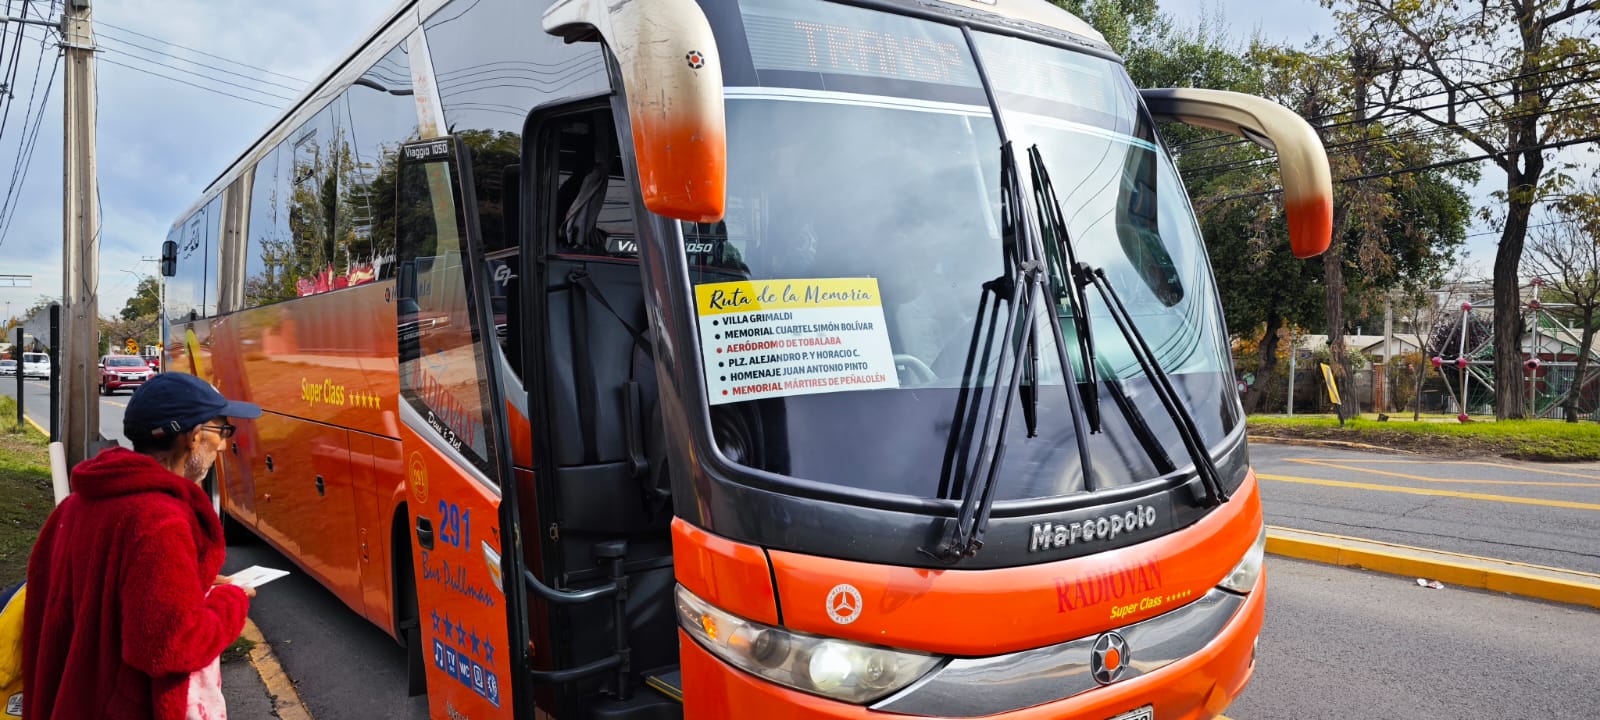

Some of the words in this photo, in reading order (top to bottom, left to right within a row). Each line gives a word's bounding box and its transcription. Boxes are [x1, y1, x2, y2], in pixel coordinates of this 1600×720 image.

[793, 20, 962, 82] TRANSP
[405, 146, 430, 159] Viaggio
[432, 143, 448, 155] 1050
[709, 287, 752, 310] Ruta
[757, 286, 777, 303] de
[782, 284, 800, 302] la
[805, 285, 872, 304] Memoria
[722, 315, 748, 325] VILLA
[750, 312, 793, 323] GRIMALDI
[724, 327, 774, 339] MEMORIAL
[775, 325, 812, 334] CUARTEL
[813, 321, 840, 333] SIMÓN
[841, 321, 874, 331] BOLÍVAR
[726, 340, 784, 353] AERÓDROMO
[786, 339, 797, 347] DE
[799, 336, 842, 346] TOBALABA
[728, 358, 747, 367] PLZ.
[749, 353, 801, 365] ALEJANDRO
[802, 352, 810, 361] P.
[810, 350, 816, 359] Y
[816, 350, 851, 360] HORACIO
[852, 349, 860, 358] C.
[730, 368, 781, 381] HOMENAJE
[783, 366, 805, 376] JUAN
[806, 364, 844, 374] ANTONIO
[844, 361, 868, 370] PINTO
[301, 377, 322, 407] Super
[324, 378, 344, 405] Class
[732, 382, 783, 396] MEMORIAL
[784, 376, 827, 389] MÁRTIRES
[828, 377, 839, 386] DE
[840, 372, 886, 384] PEÑALOLÉN
[439, 499, 470, 552] 291
[1030, 504, 1156, 551] Marcopolo
[422, 551, 441, 584] Bus
[443, 560, 494, 607] Pullman
[1054, 555, 1163, 614] RADIOVAN
[1110, 602, 1138, 620] Super
[1139, 596, 1162, 611] Class
[446, 650, 455, 666] TV
[459, 662, 470, 678] WC
